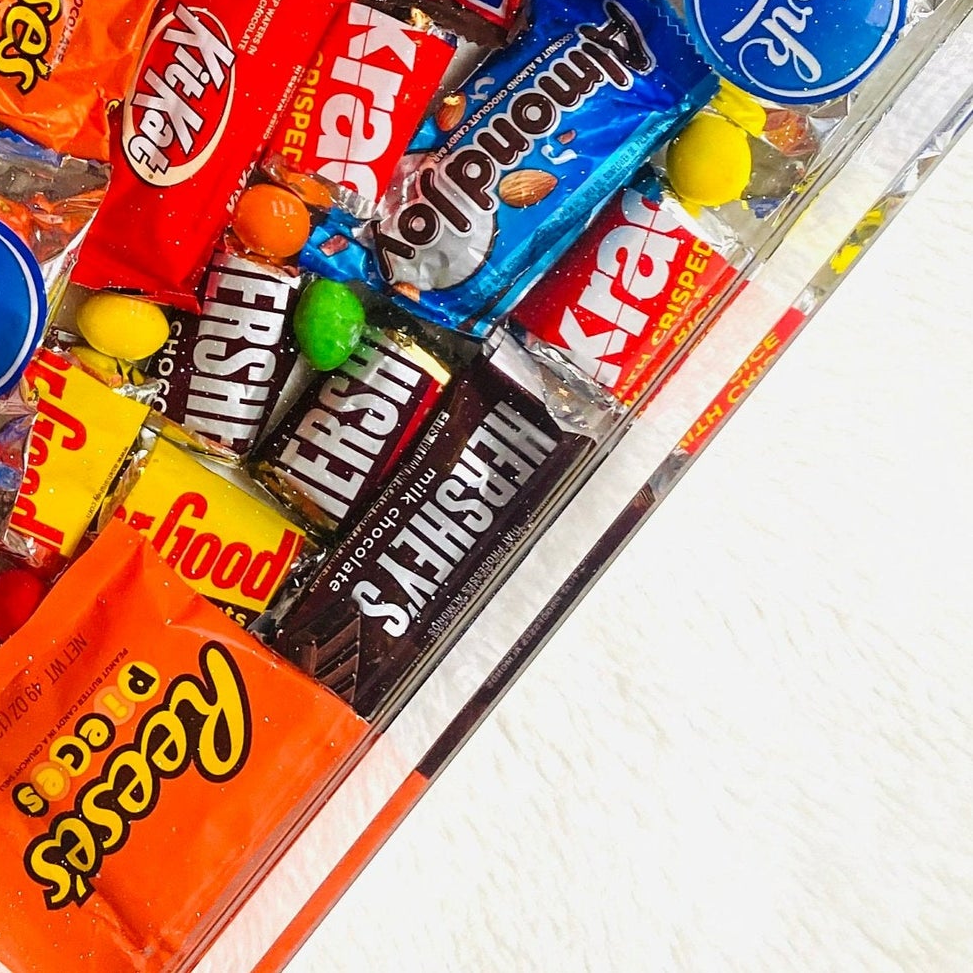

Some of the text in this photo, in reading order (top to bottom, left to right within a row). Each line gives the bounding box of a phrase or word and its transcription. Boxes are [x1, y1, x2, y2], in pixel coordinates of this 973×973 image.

[252, 6, 275, 45] WAFERS
[246, 44, 257, 56] IN
[534, 54, 544, 65] &
[504, 61, 538, 92] ALMOND
[465, 87, 510, 127] CHOCOLATE
[442, 123, 471, 149] CANDY
[428, 144, 448, 163] BAR
[373, 169, 470, 281] Joy
[399, 466, 441, 509] milk
[352, 400, 562, 638] HERSHEY'S
[322, 504, 407, 595] chocolate
[57, 631, 88, 664] NET
[99, 644, 129, 680] PEANUT
[39, 655, 69, 686] WT
[76, 674, 103, 707] BUTTER
[4, 693, 32, 723] OZ
[54, 701, 80, 732] CANDY
[41, 737, 50, 746] A
[46, 728, 57, 740] IN
[11, 740, 45, 779] CRUNCHY
[24, 640, 253, 911] Reese's
